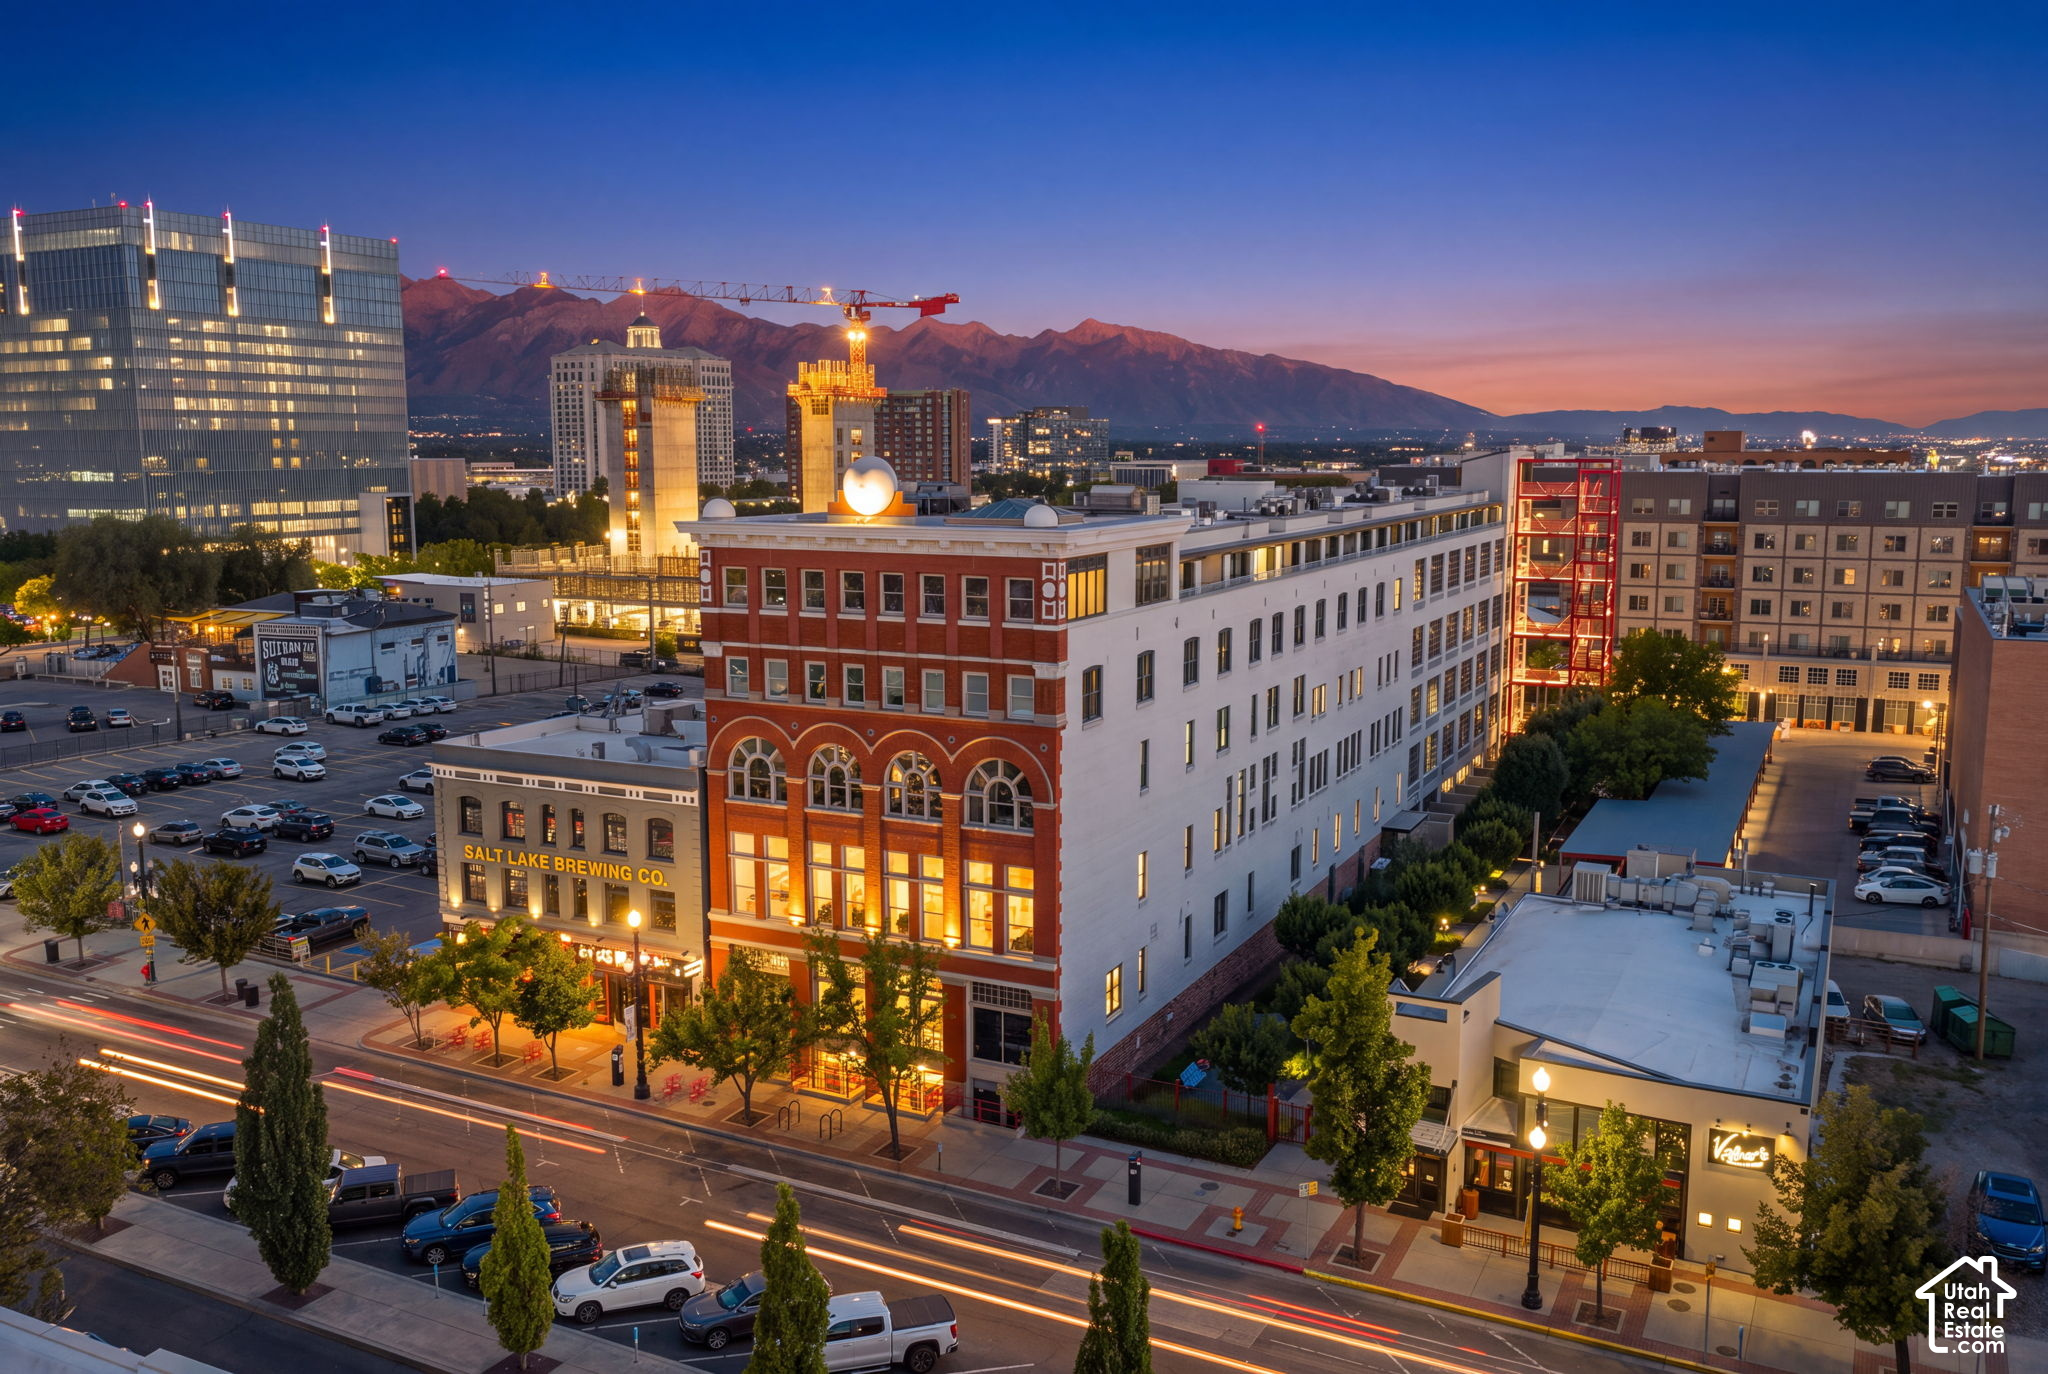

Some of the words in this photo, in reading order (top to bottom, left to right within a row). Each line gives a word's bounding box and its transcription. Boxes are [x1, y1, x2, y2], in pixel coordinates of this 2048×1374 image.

[464, 844, 503, 863] SALT
[507, 849, 550, 869] LAKE
[554, 856, 632, 881] BREWING
[637, 867, 668, 887] CO.
